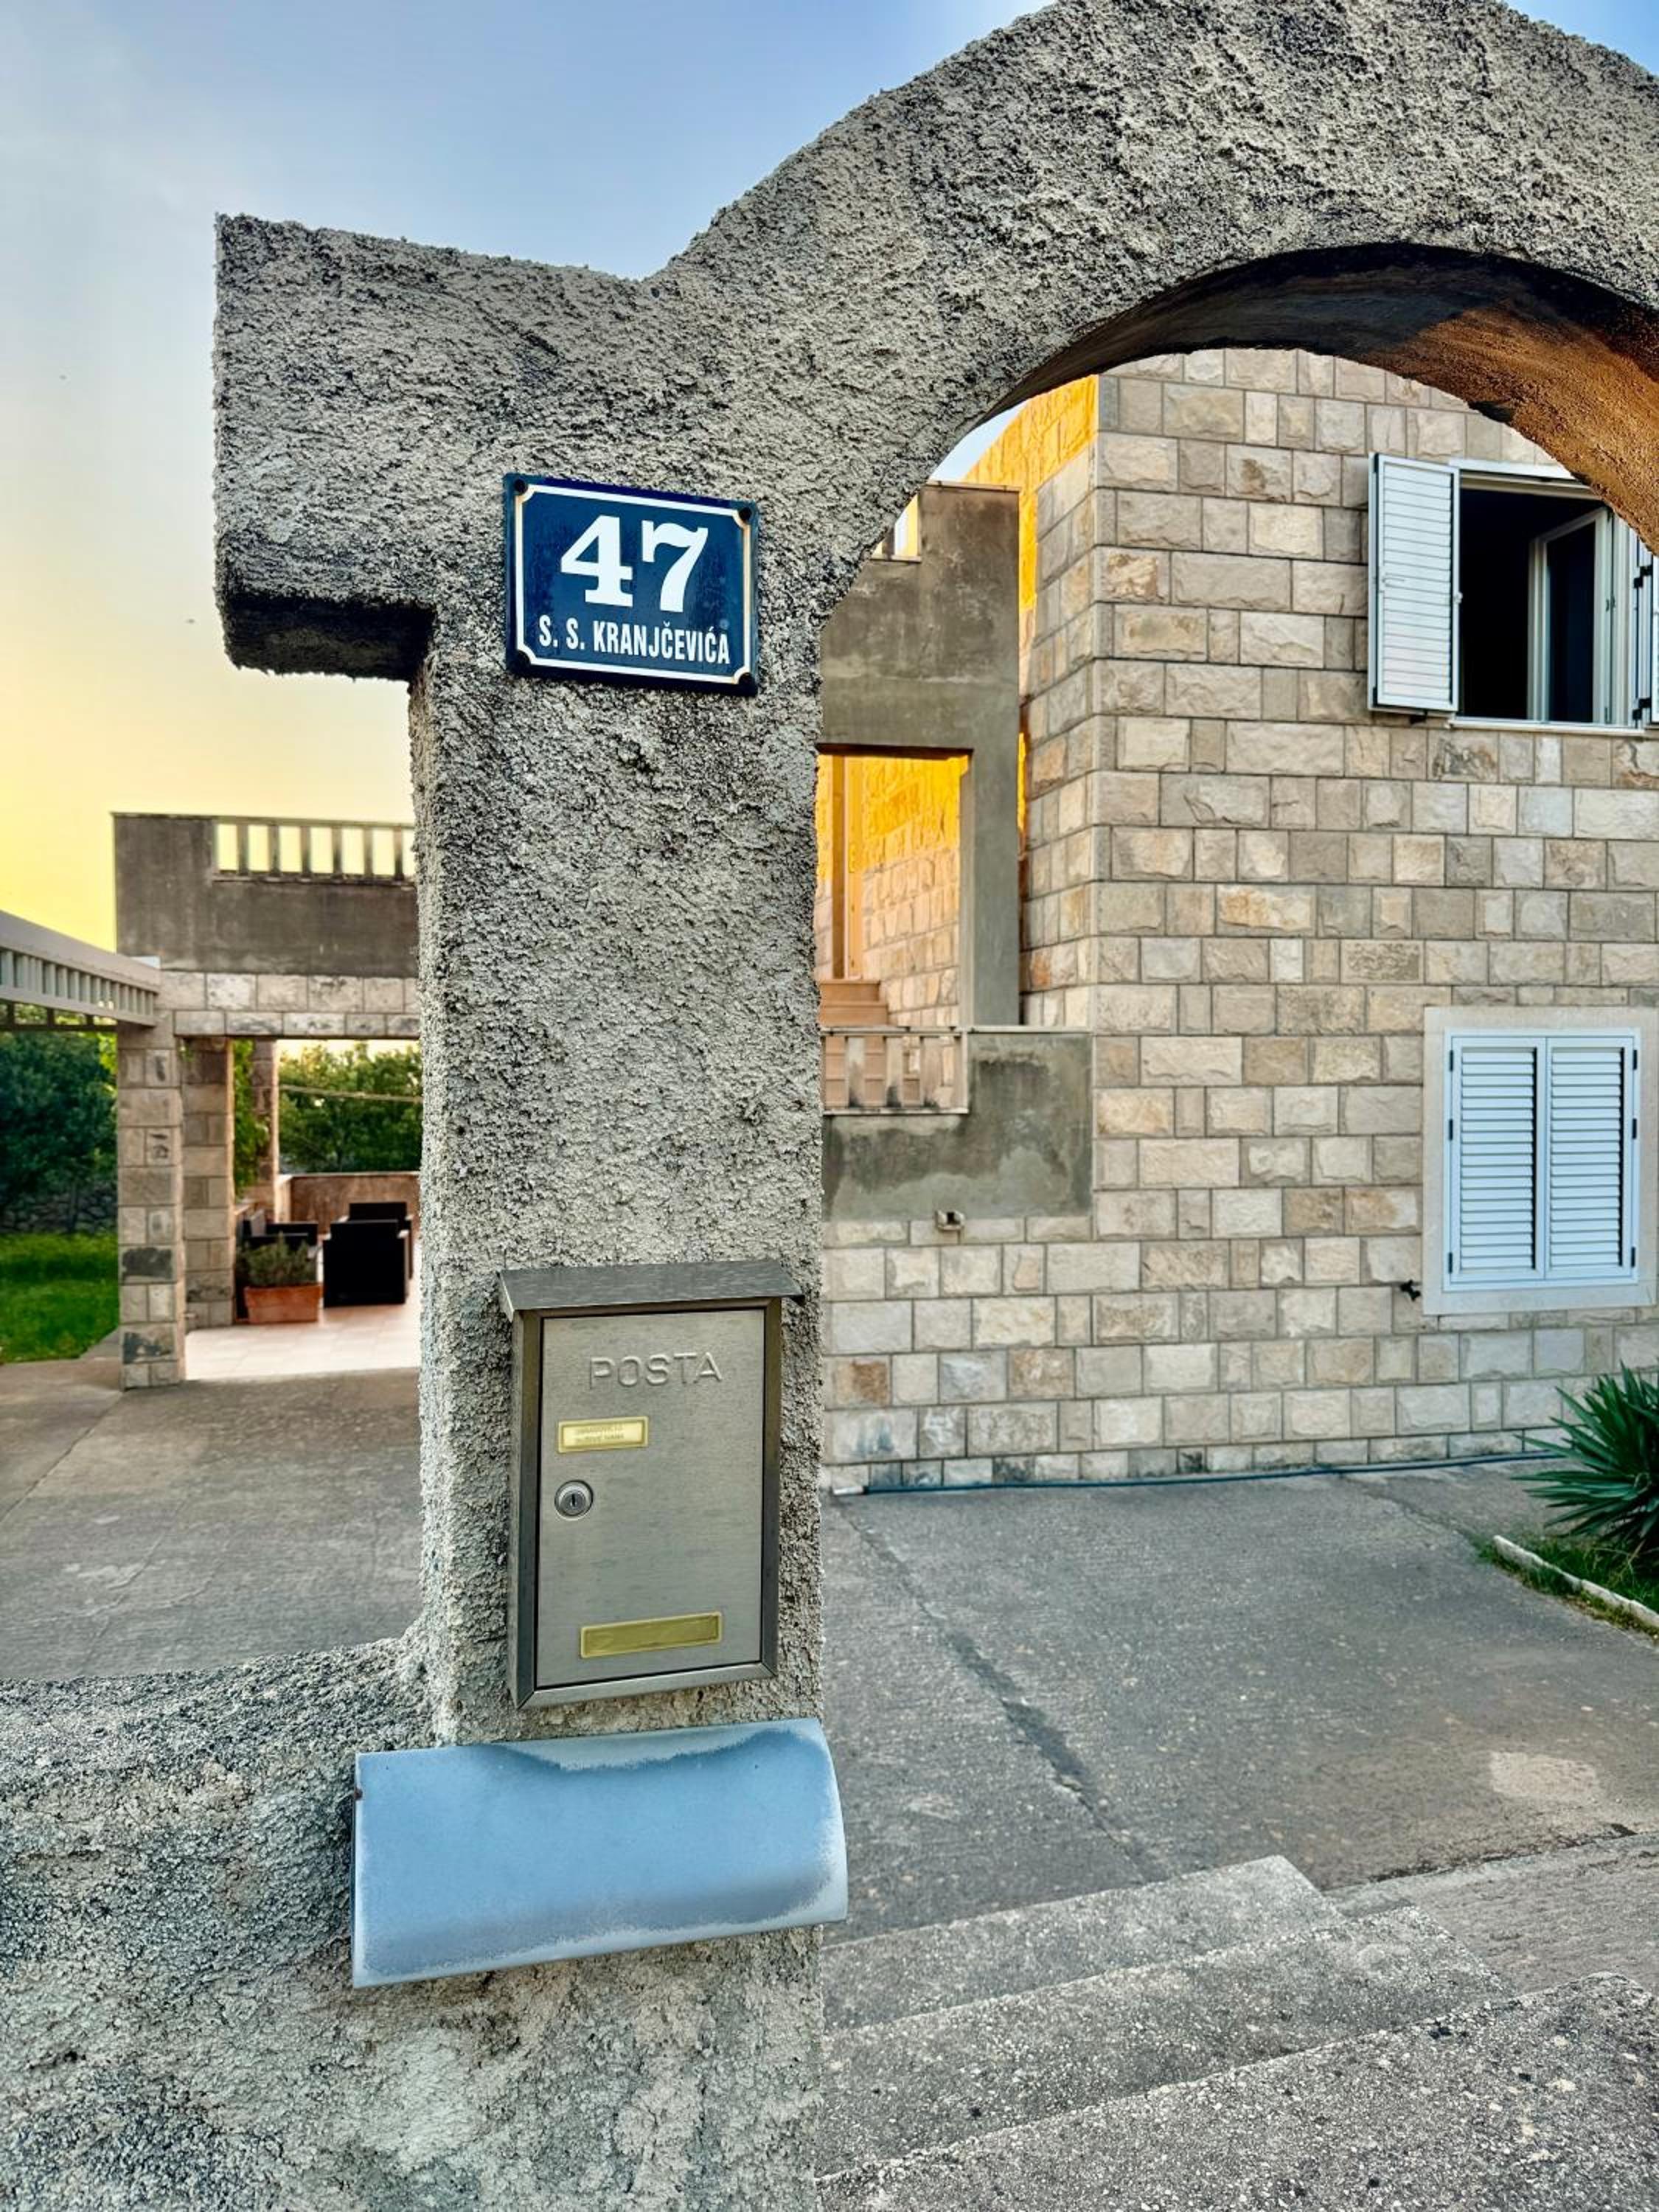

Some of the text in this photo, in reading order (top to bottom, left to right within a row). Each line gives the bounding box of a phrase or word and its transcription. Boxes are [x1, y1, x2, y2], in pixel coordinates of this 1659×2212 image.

[560, 515, 709, 613] 47
[539, 615, 731, 664] S. S. KRANJČEVIĆA
[590, 1352, 723, 1390] POSTA
